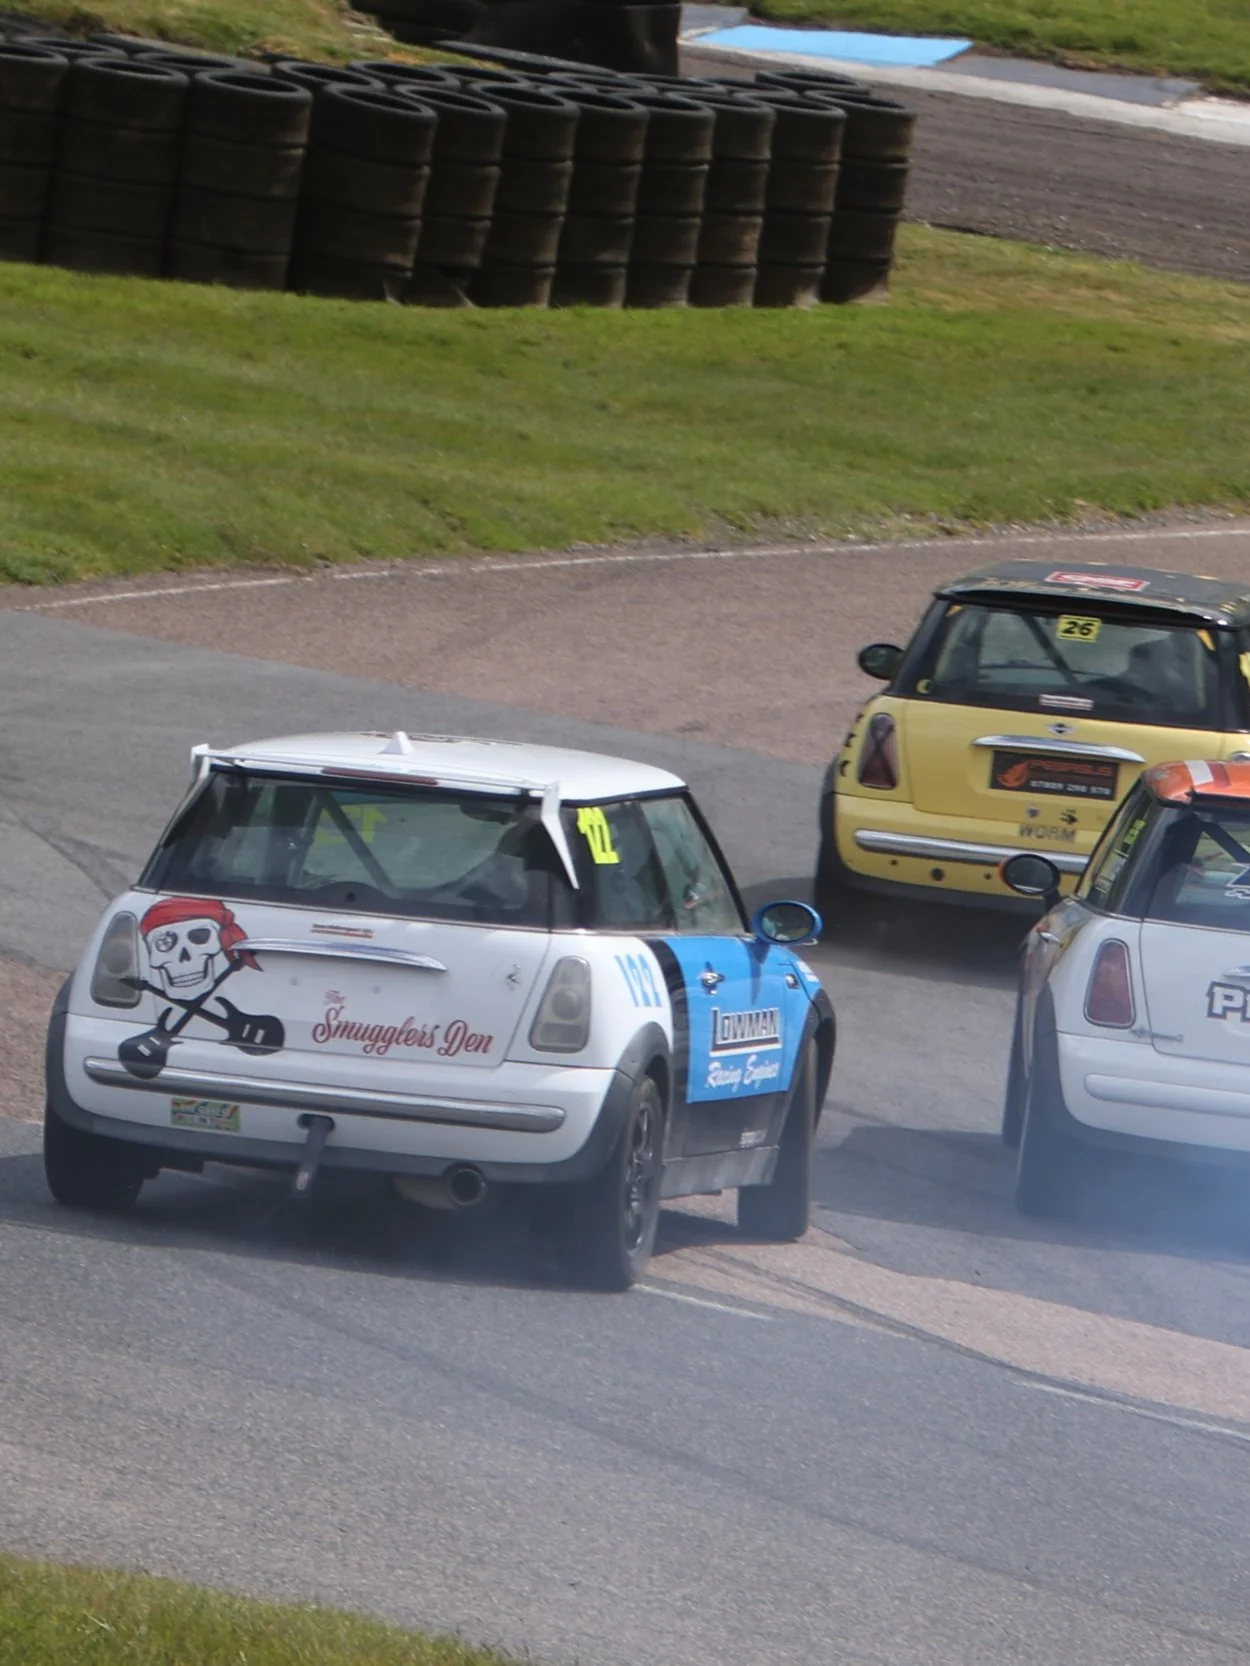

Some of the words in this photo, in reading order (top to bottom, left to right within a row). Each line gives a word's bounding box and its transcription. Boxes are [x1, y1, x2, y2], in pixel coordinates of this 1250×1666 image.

[1061, 621, 1095, 636] 26
[437, 1019, 495, 1057] Den
[711, 1006, 780, 1046] LOWMAN
[705, 1061, 743, 1093] Racing
